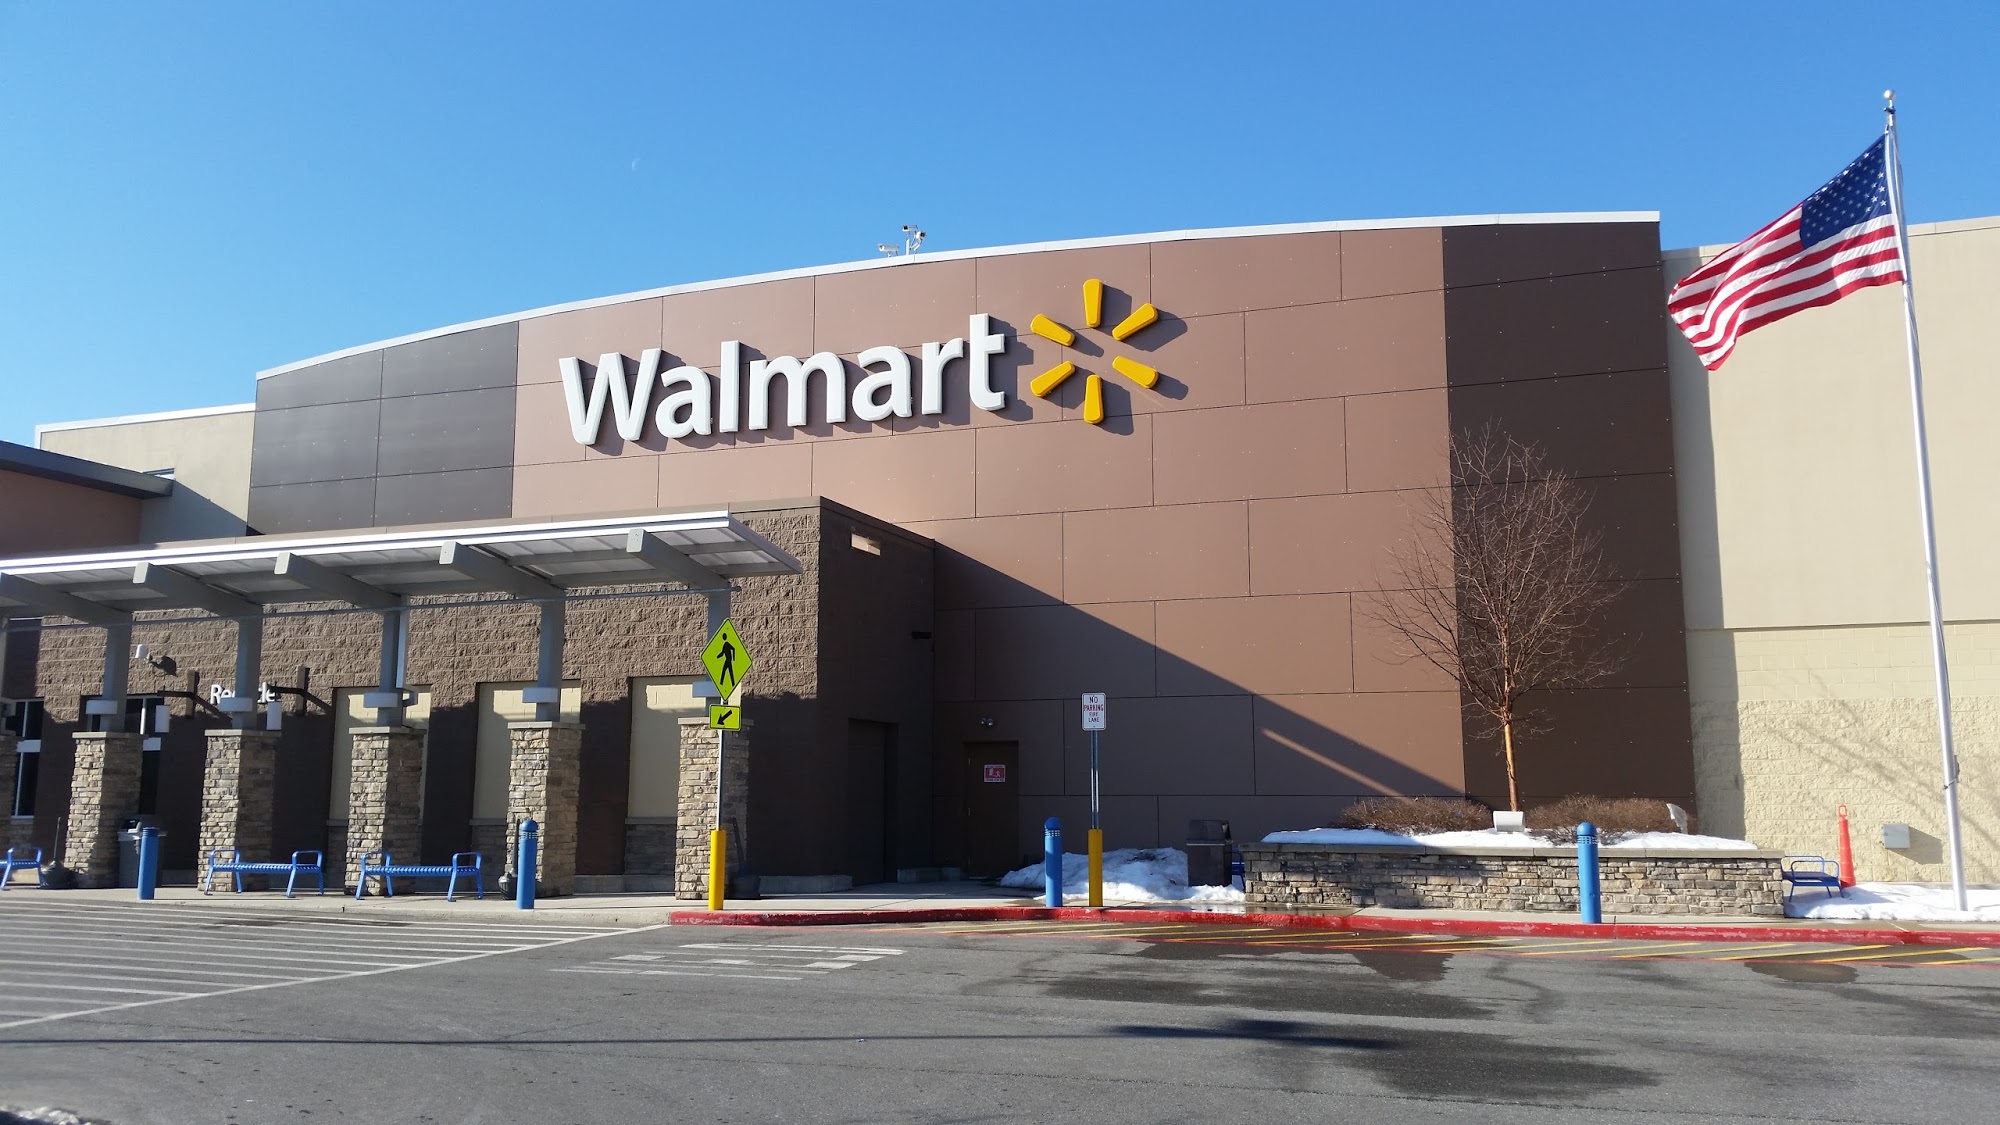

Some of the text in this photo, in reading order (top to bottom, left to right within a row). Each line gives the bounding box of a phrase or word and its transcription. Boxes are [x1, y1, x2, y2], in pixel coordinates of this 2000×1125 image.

[559, 313, 1006, 445] Walmart
[210, 681, 275, 705] Rele
[1089, 696, 1099, 704] NO
[1084, 704, 1104, 712] PARKING
